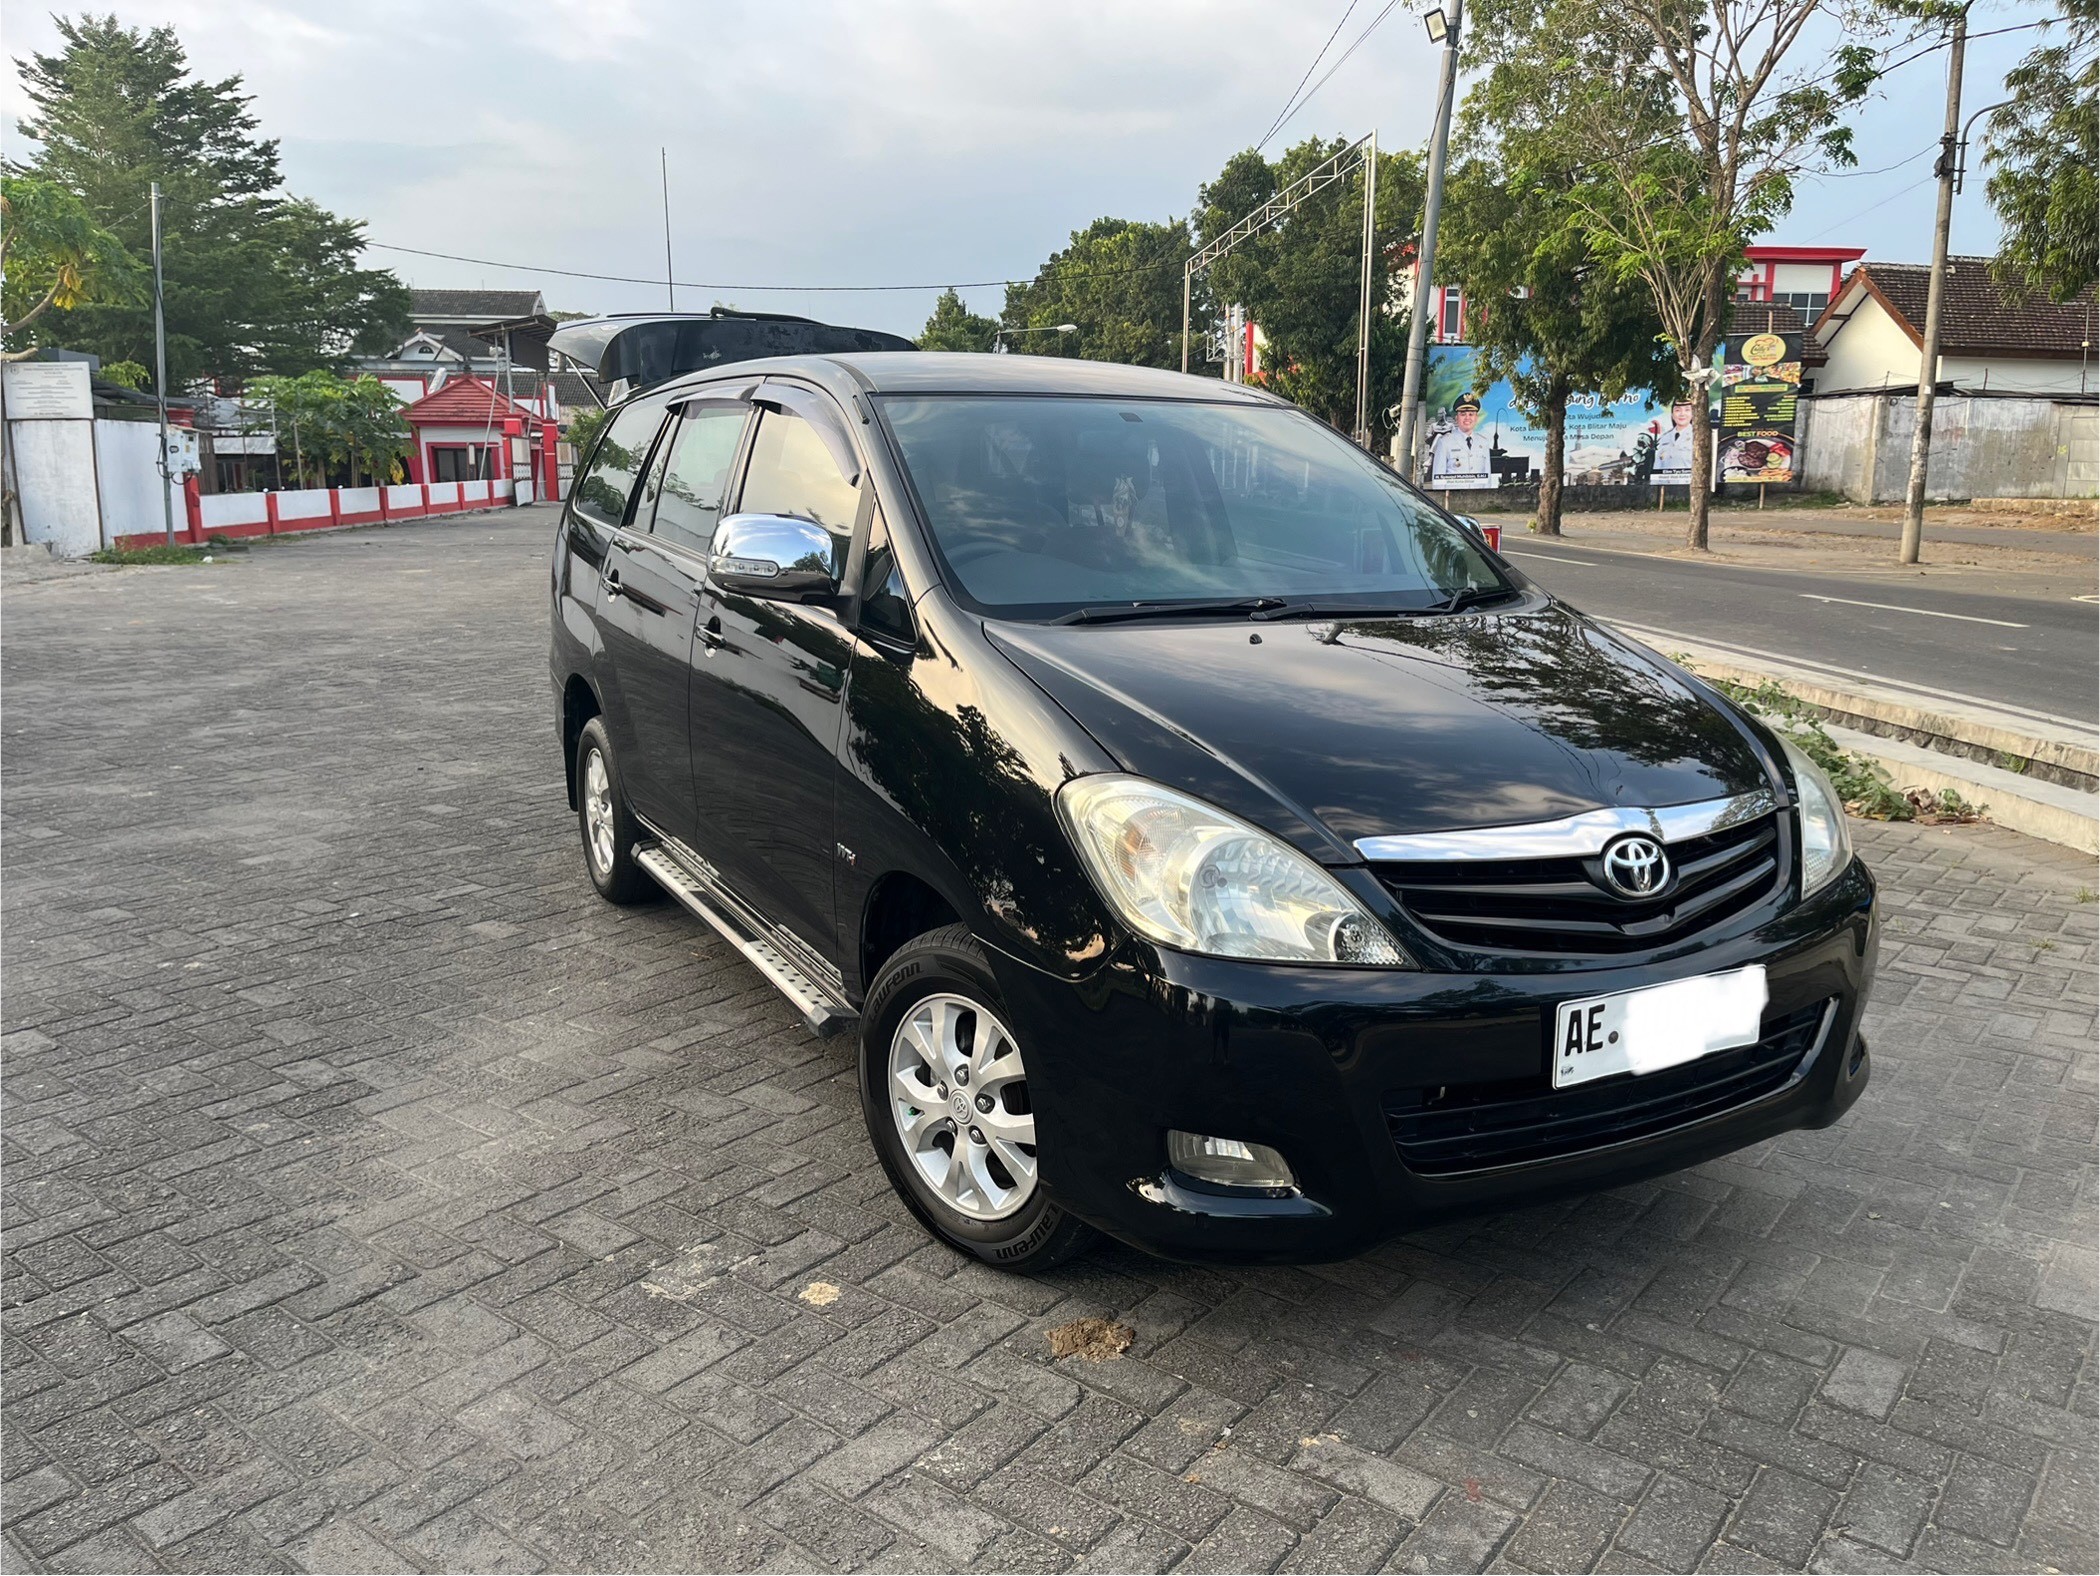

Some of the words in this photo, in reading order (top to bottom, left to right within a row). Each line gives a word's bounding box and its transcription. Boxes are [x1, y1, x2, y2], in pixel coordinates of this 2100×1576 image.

[1608, 422, 1628, 430] Maju
[1590, 433, 1615, 441] Depan
[1564, 1003, 1606, 1057] AE
